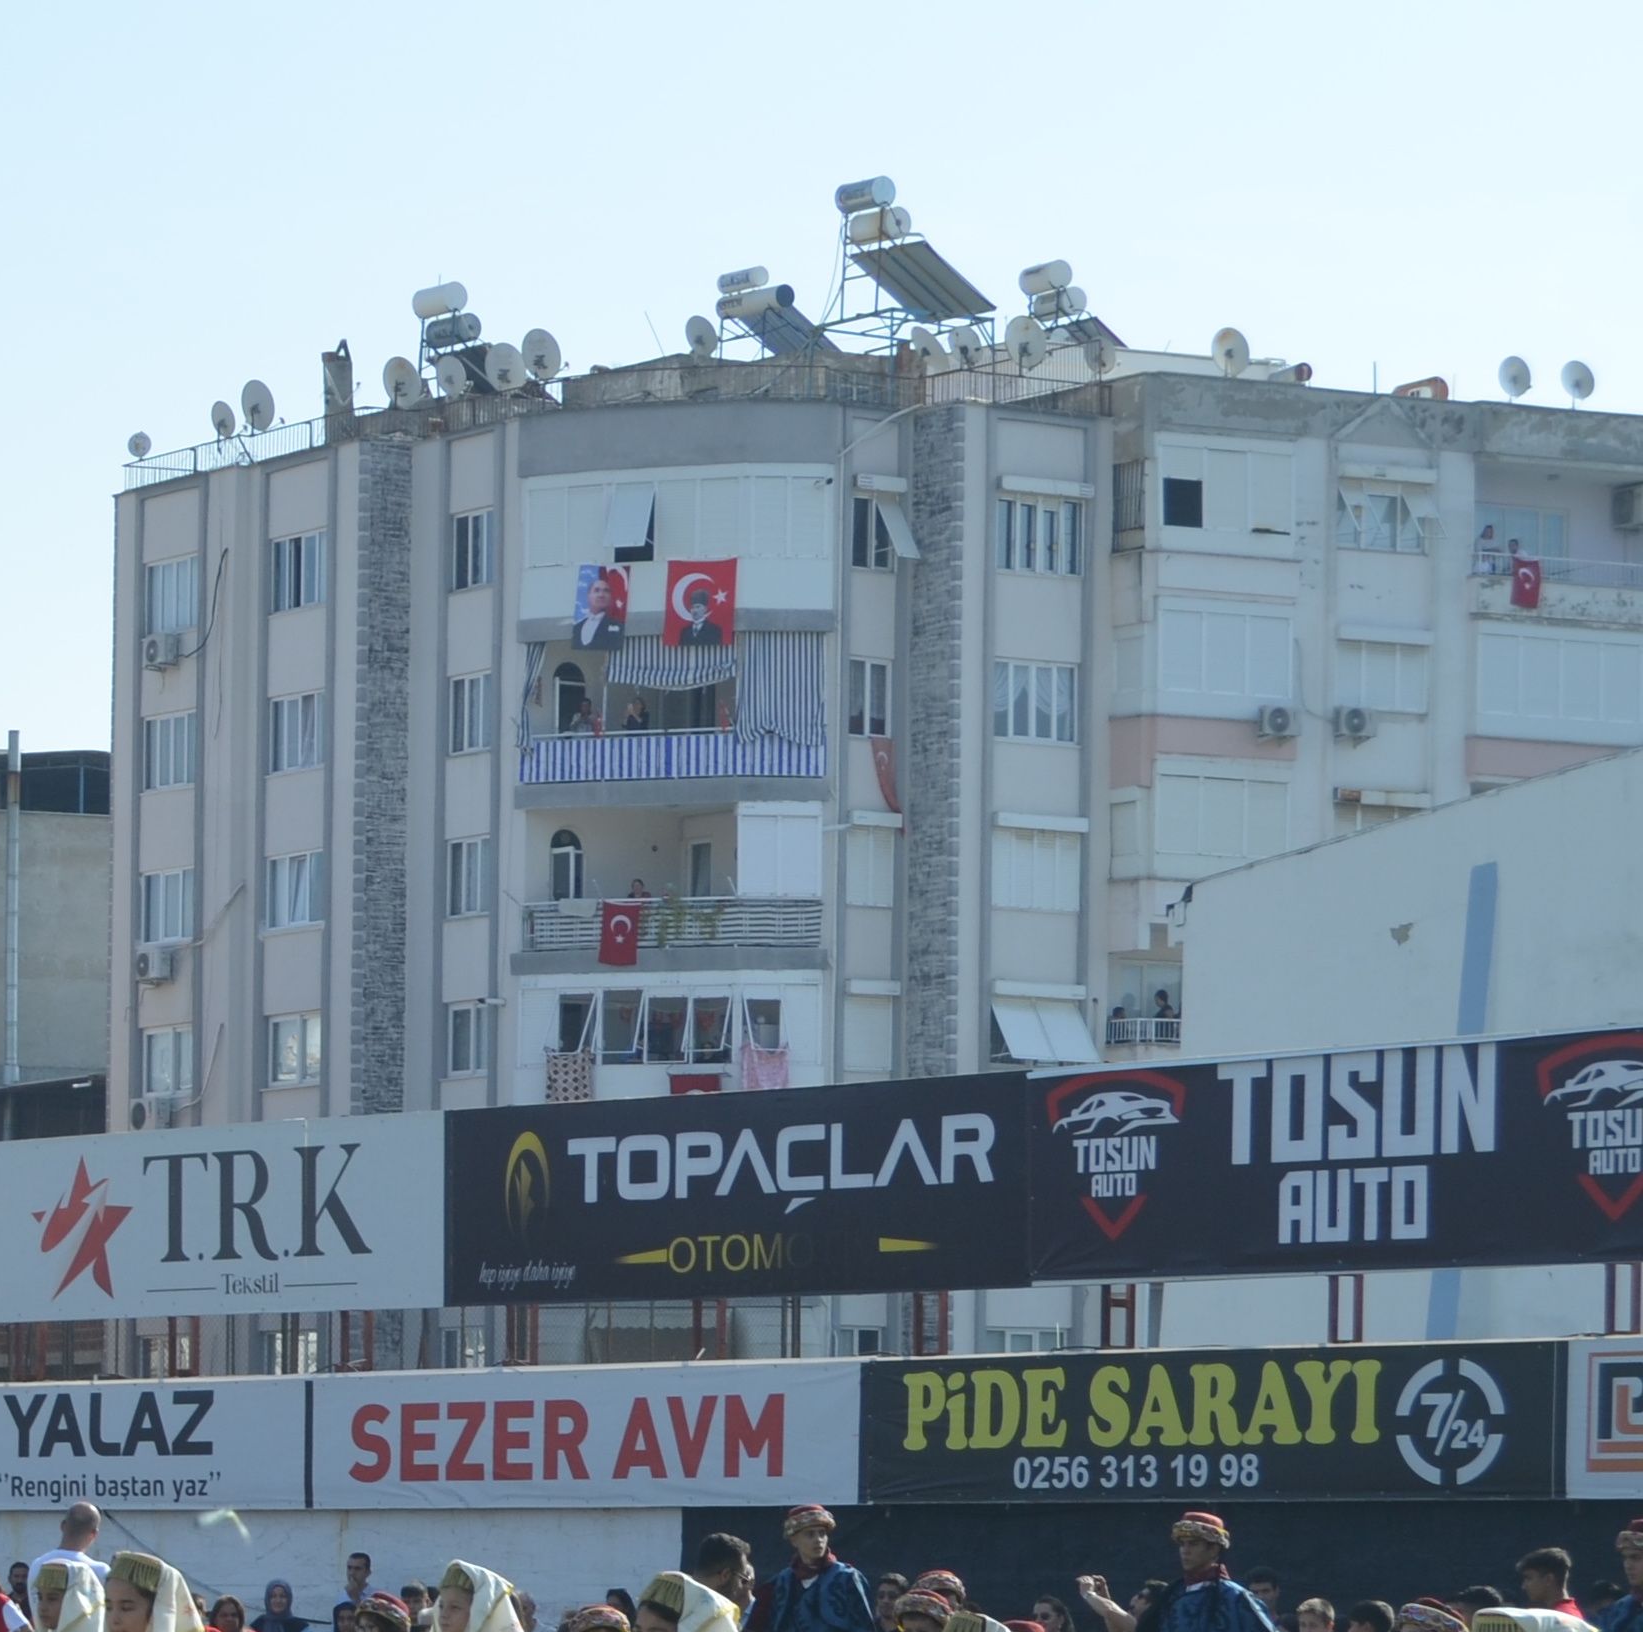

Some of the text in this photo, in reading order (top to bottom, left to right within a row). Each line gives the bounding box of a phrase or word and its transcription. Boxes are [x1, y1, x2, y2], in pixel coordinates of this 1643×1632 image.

[1217, 1043, 1497, 1165] TOSUN
[567, 1113, 997, 1215] TOPAÇLAR
[1073, 1136, 1156, 1173] TOSUN
[1589, 1148, 1641, 1175] AUTO
[1091, 1173, 1137, 1197] AUTO
[1278, 1165, 1428, 1244] AUTO
[221, 1272, 279, 1295] Tekstil
[3, 1390, 214, 1458] YALAZ
[1087, 1359, 1382, 1448] SARAYI
[348, 1393, 785, 1483] SEZER AVM
[95, 1474, 164, 1501] baştan
[1014, 1453, 1259, 1489] 0256 313 19 98
